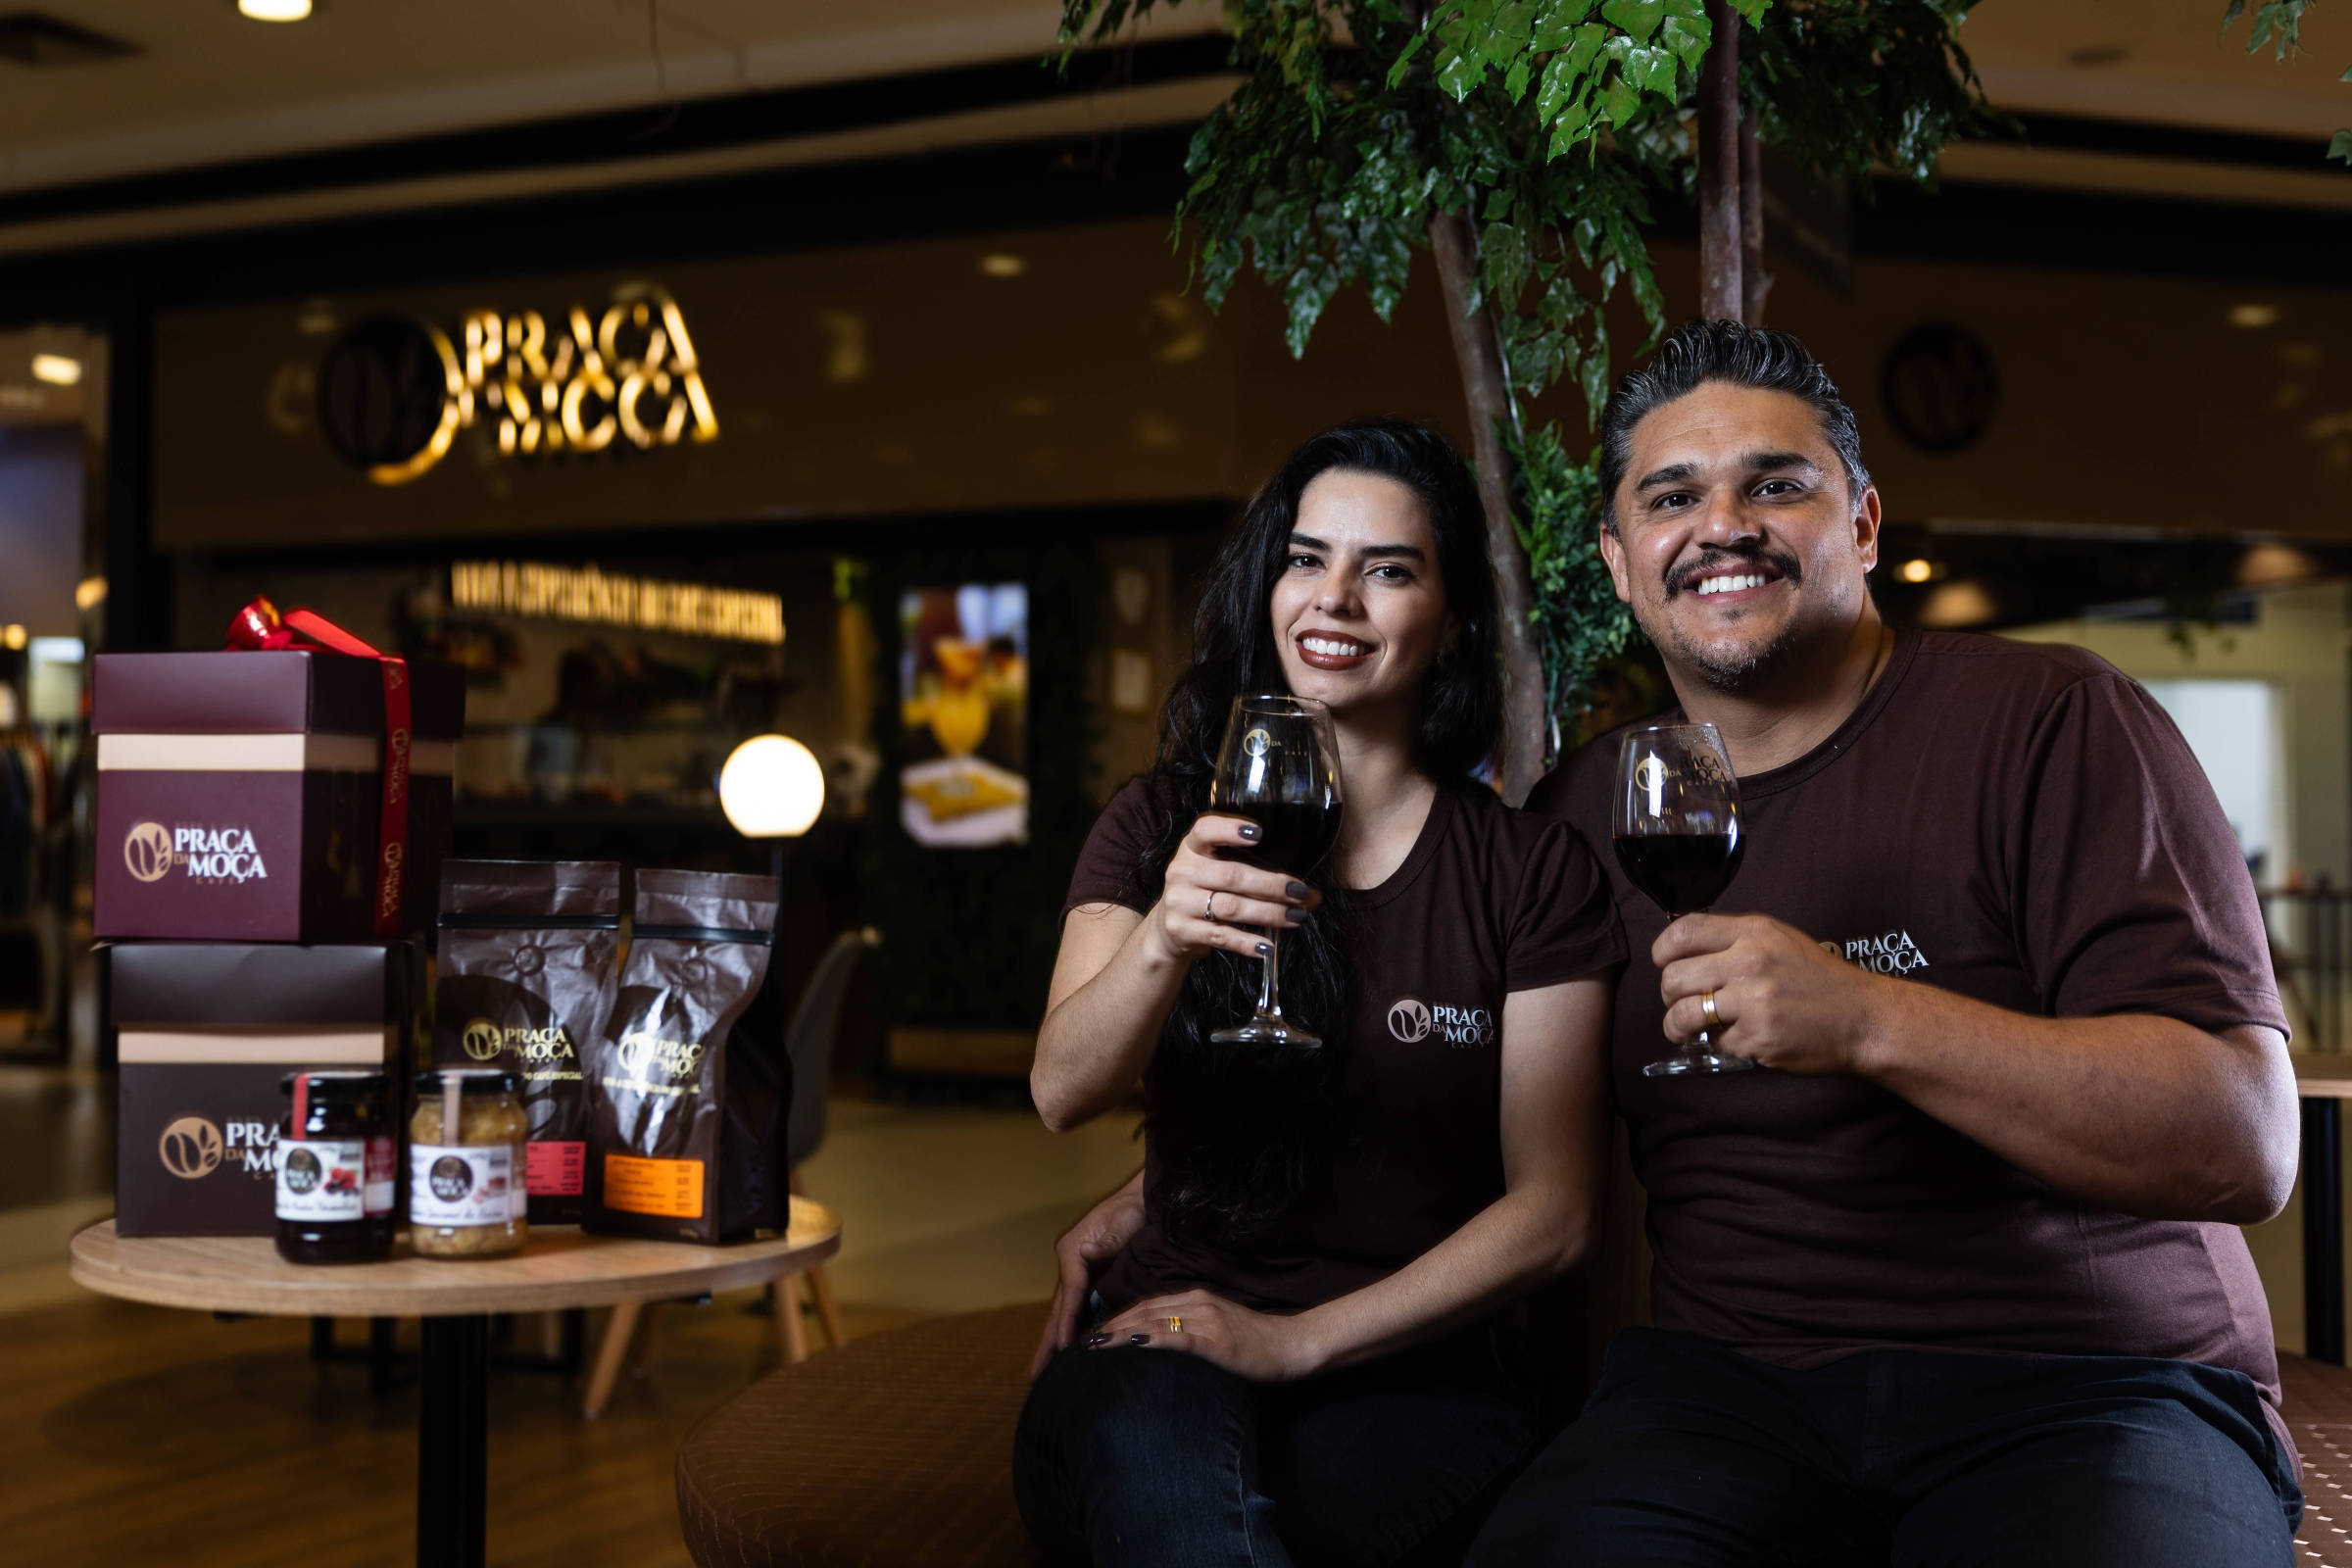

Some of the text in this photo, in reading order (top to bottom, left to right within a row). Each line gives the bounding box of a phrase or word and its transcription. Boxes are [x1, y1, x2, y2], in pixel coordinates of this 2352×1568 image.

[174, 828, 257, 856] PRAÇA
[187, 854, 268, 884] MOÇA
[1845, 929, 1916, 959] PRAÇA
[1859, 949, 1930, 974] MOÇA
[1432, 1005, 1494, 1030] PRAÇA
[1432, 1024, 1494, 1047] DA MOÇA
[225, 1122, 280, 1148] PRA
